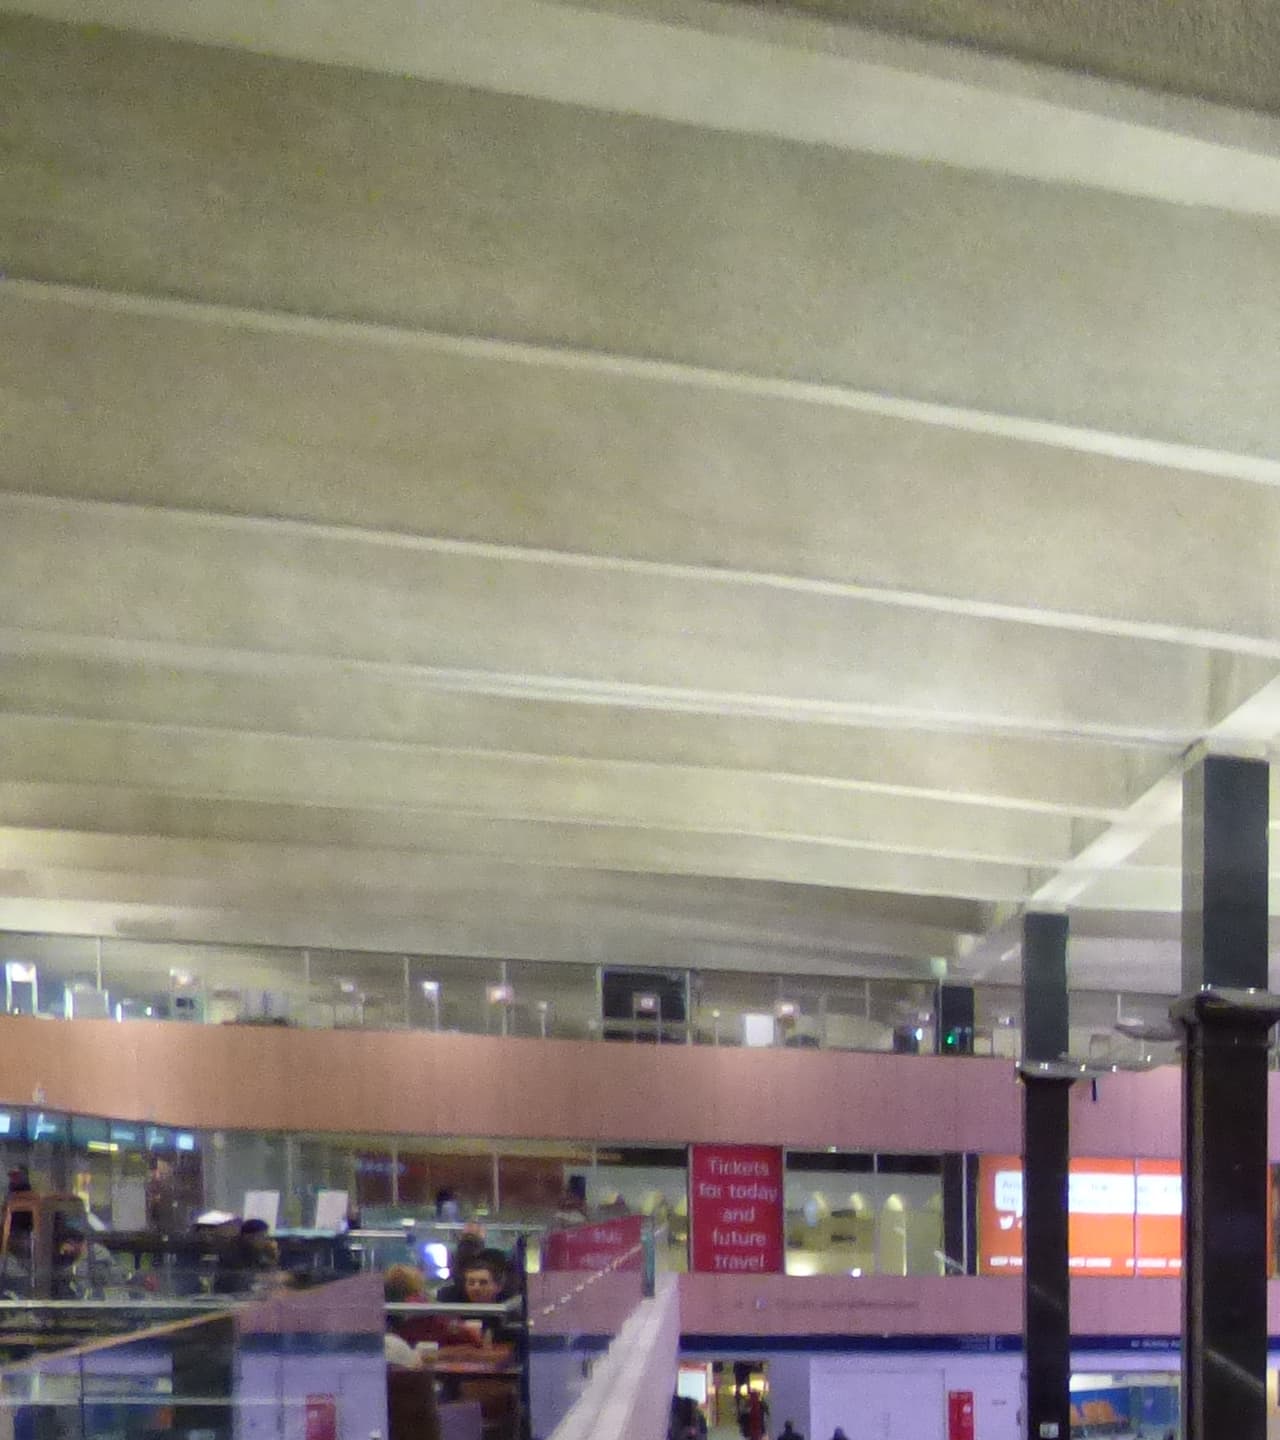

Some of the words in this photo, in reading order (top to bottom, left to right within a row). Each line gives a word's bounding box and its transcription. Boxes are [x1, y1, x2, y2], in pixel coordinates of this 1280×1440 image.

[710, 1158, 769, 1176] Tickets
[700, 1183, 721, 1197] for
[731, 1183, 778, 1203] today
[723, 1206, 755, 1222] and
[713, 1227, 766, 1246] future
[715, 1254, 765, 1269] travel
